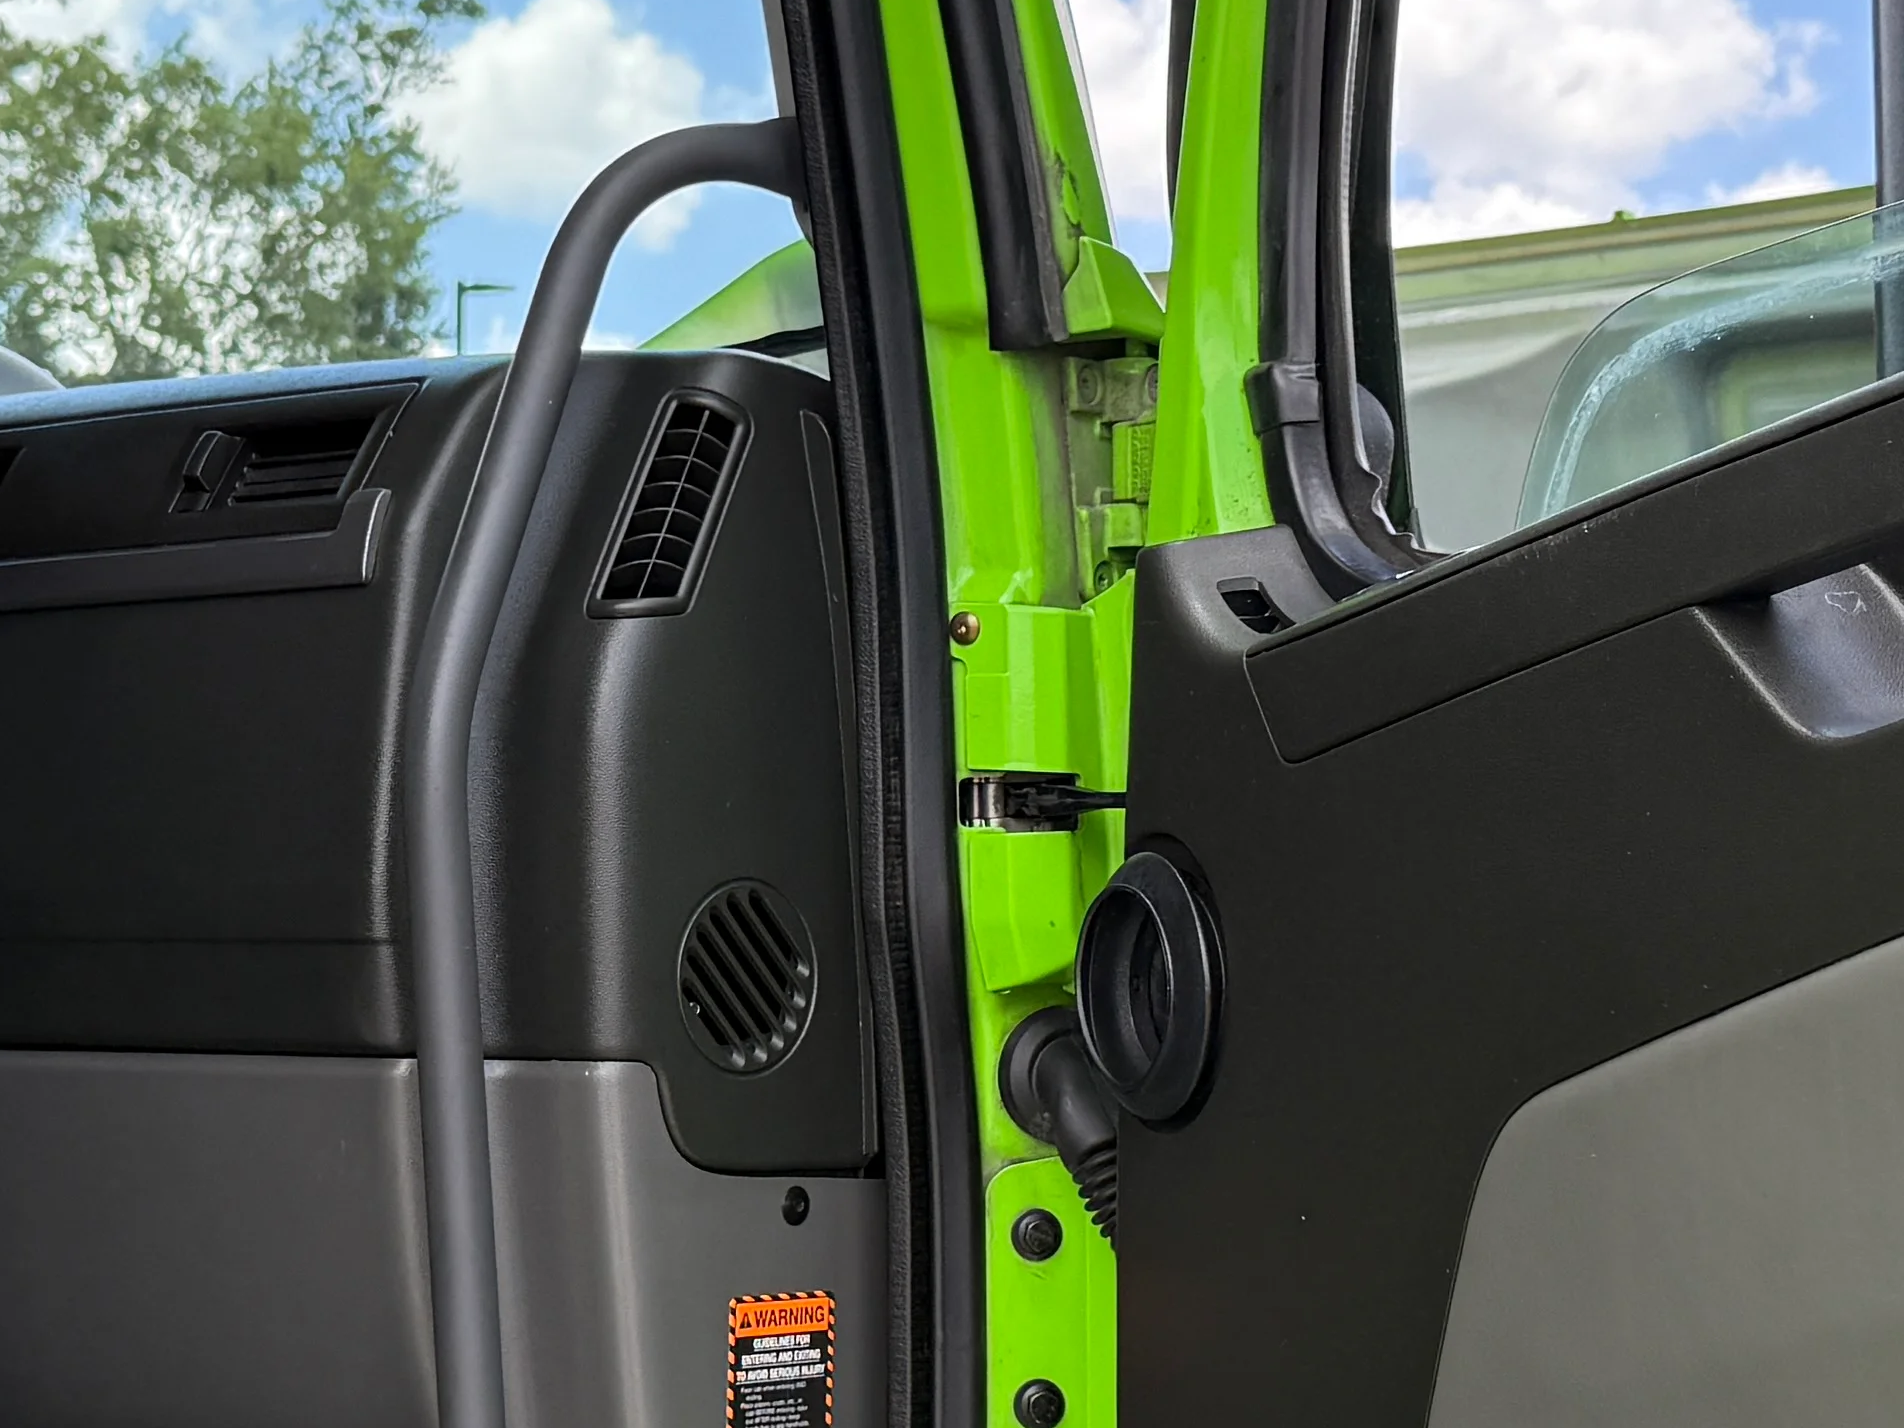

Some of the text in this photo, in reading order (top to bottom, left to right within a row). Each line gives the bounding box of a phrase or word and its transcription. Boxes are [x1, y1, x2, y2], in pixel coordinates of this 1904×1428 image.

[754, 1306, 824, 1328] WARNING
[753, 1334, 810, 1349] GUIDELINES FOR
[741, 1349, 821, 1366] ENTERING AND EXITING
[736, 1364, 825, 1381] TO AVOID SERIOUS INJURY
